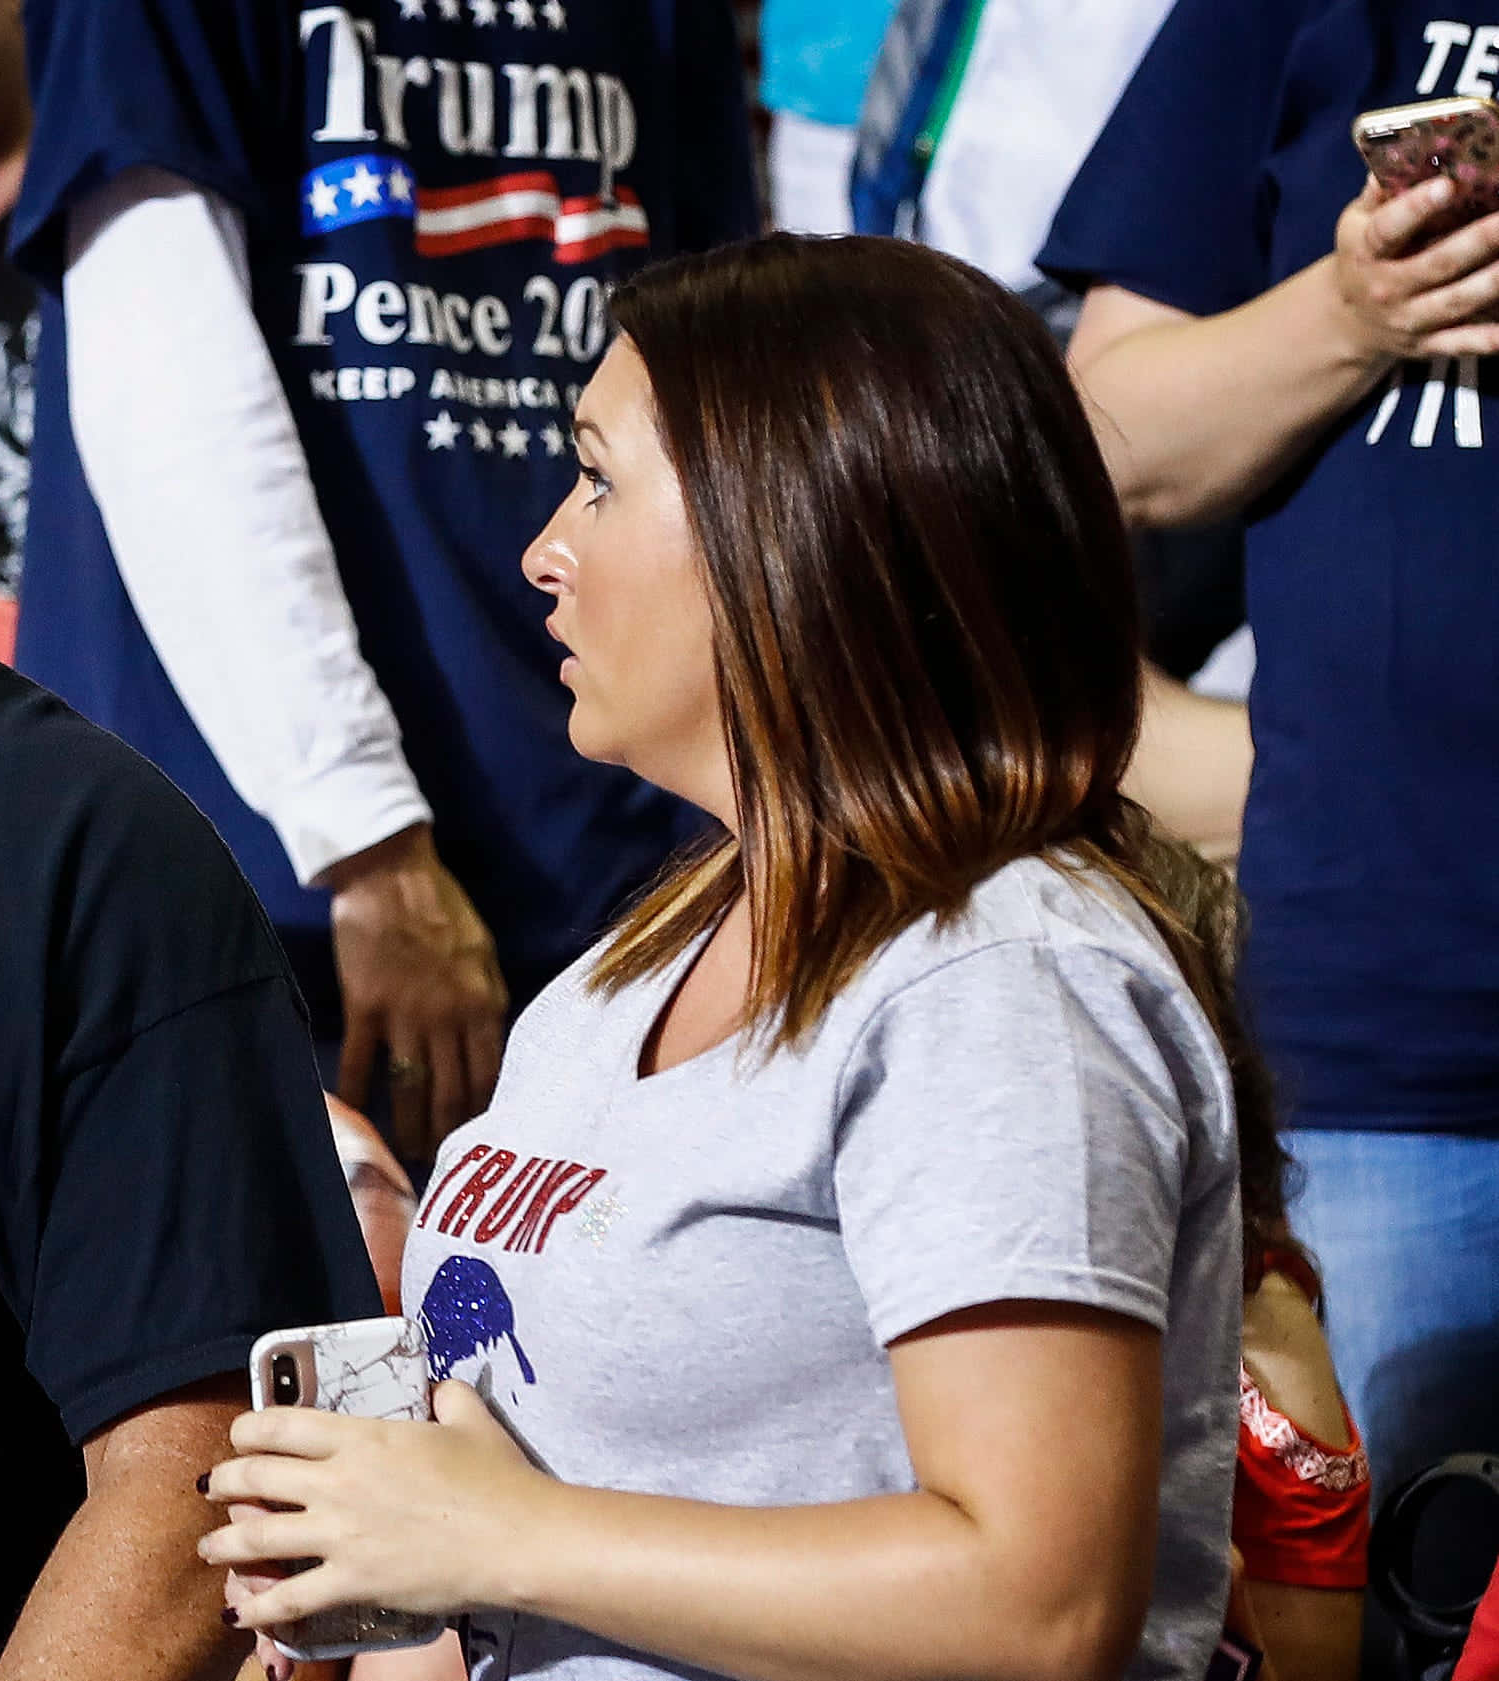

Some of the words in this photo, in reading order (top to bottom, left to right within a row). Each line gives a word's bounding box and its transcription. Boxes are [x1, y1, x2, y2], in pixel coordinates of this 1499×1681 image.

[300, 5, 637, 202] Trump
[293, 262, 512, 356] Pence
[309, 366, 416, 401] KEEP
[429, 368, 561, 409] AMERICA
[416, 1144, 608, 1254] TRUMP
